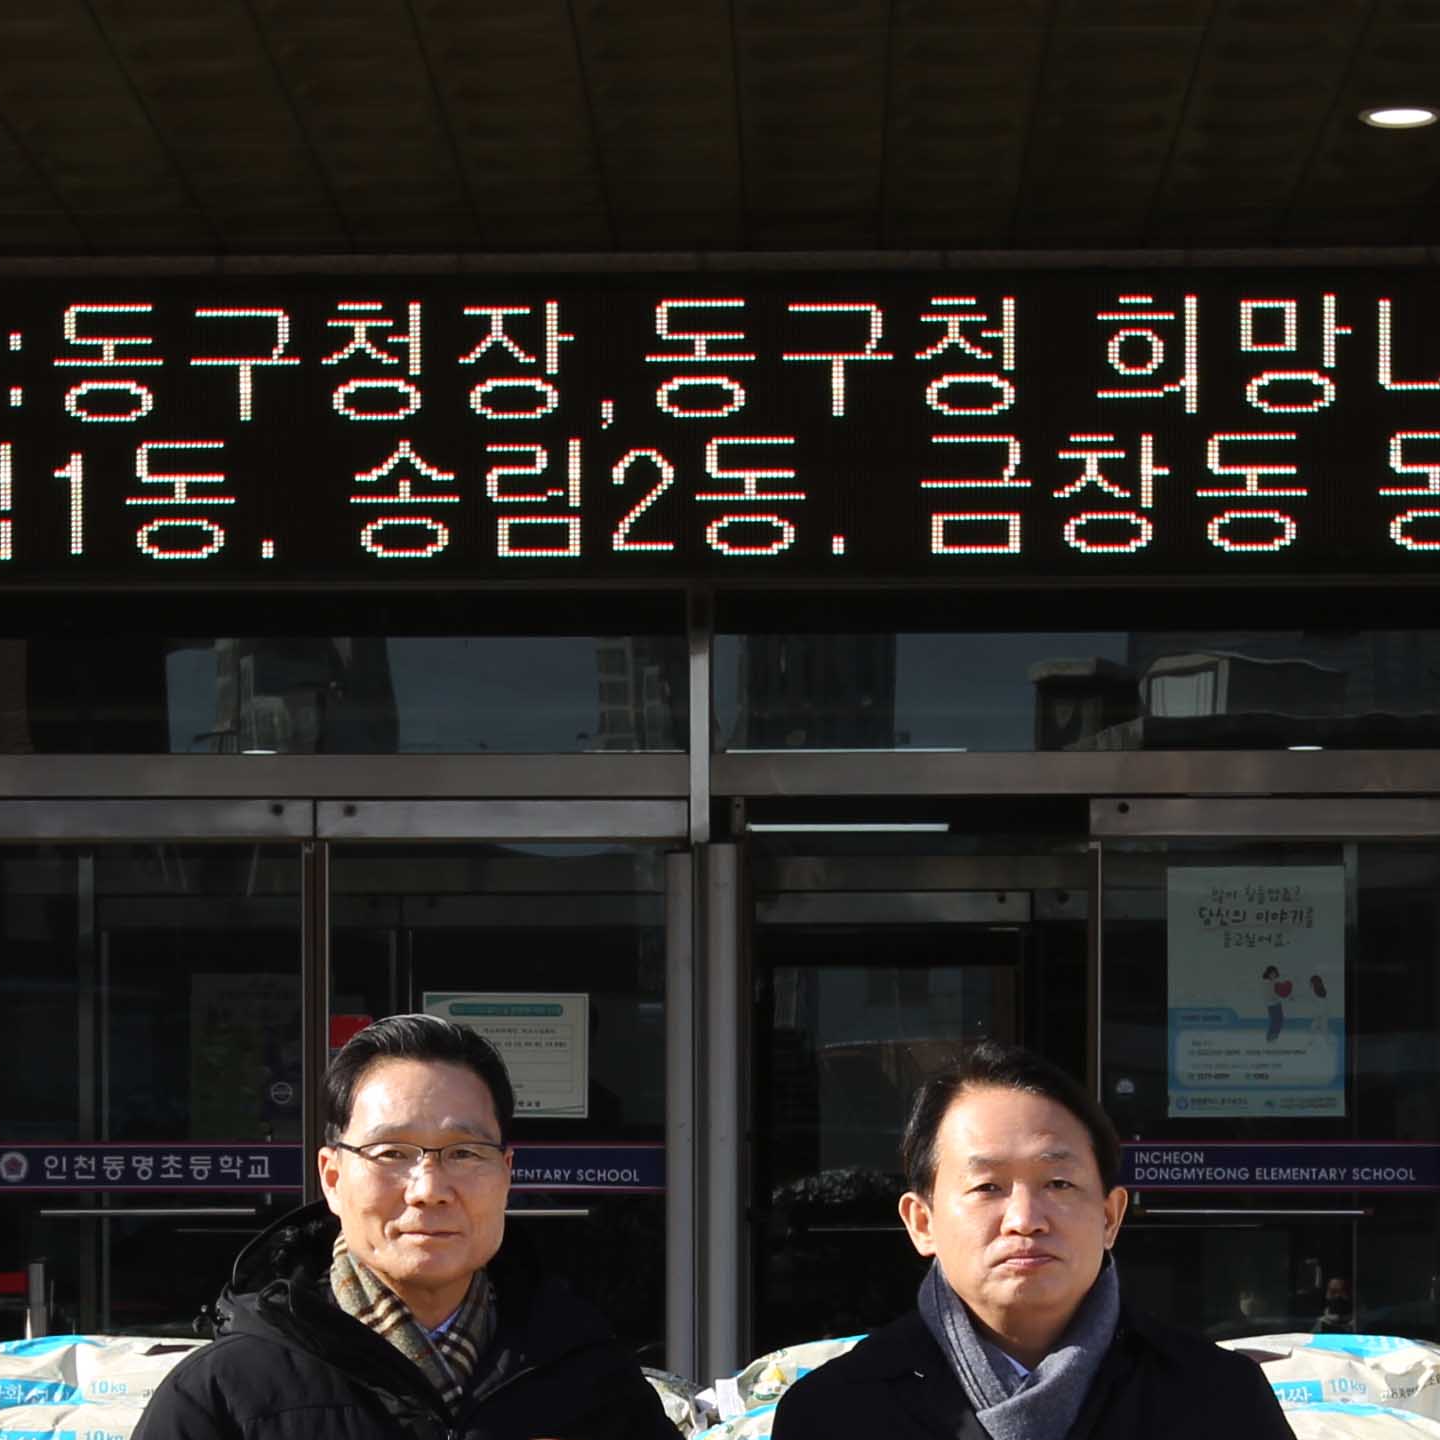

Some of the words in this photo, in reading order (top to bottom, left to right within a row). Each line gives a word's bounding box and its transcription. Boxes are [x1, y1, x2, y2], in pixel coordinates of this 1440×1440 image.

[921, 431, 1308, 555] 금창동
[1134, 1151, 1204, 1165] INCHEON
[44, 1153, 271, 1181] 인천동명초등학교
[1134, 1167, 1249, 1181] DONGMYEONG
[1255, 1167, 1347, 1181] ELEMENTARY
[1352, 1167, 1416, 1181] SCHOOL
[511, 1169, 571, 1181] ENTARY
[576, 1169, 640, 1182] SCHOOL
[91, 1382, 128, 1396] 10kg
[1330, 1379, 1367, 1394] 10kg
